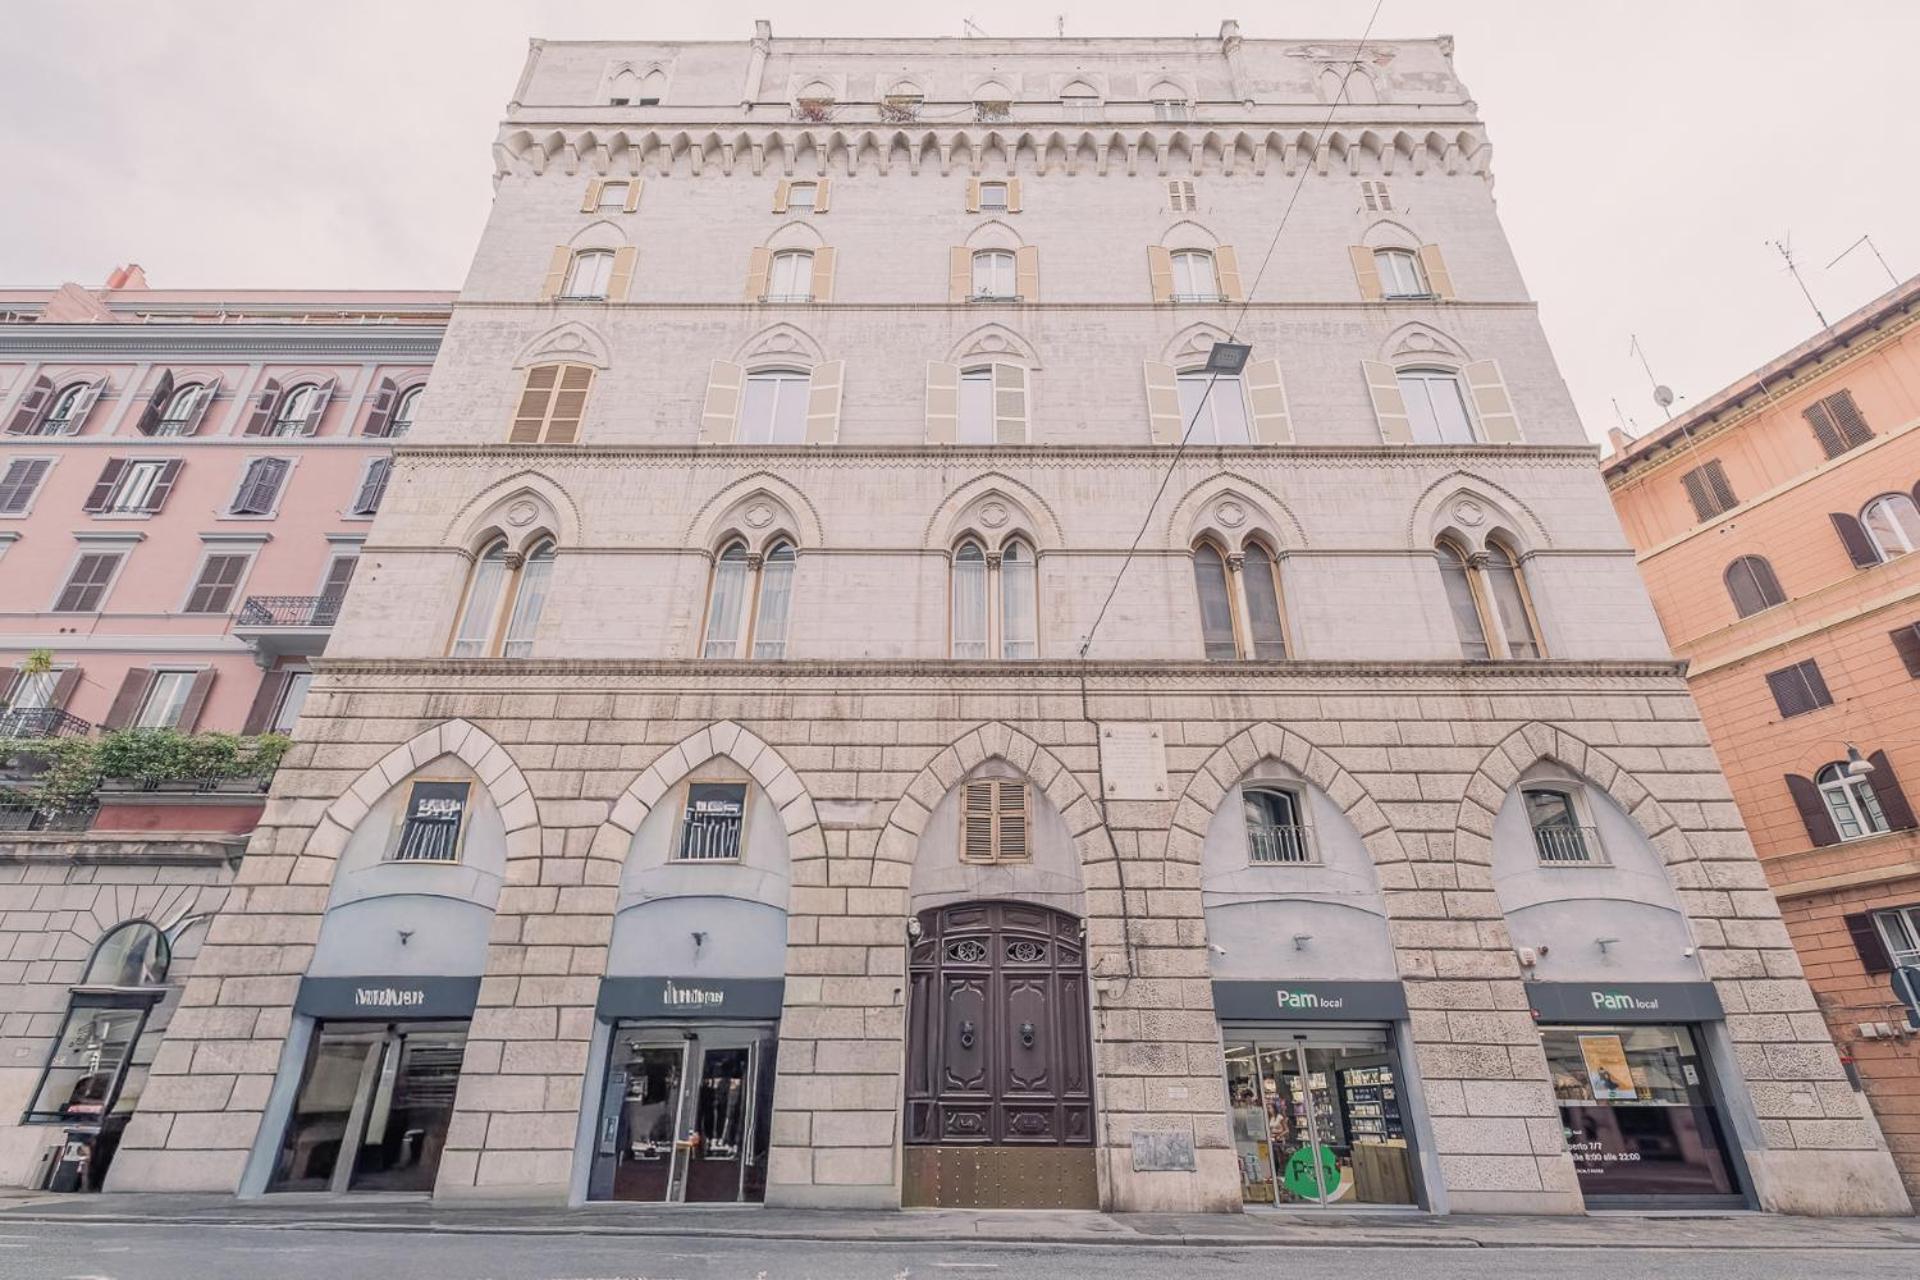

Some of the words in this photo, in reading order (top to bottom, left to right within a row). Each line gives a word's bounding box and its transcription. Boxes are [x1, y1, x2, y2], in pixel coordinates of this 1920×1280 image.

[1276, 990, 1318, 1008] Pam
[1320, 998, 1343, 1008] local
[1591, 992, 1635, 1008] Pam
[1635, 998, 1659, 1009] local
